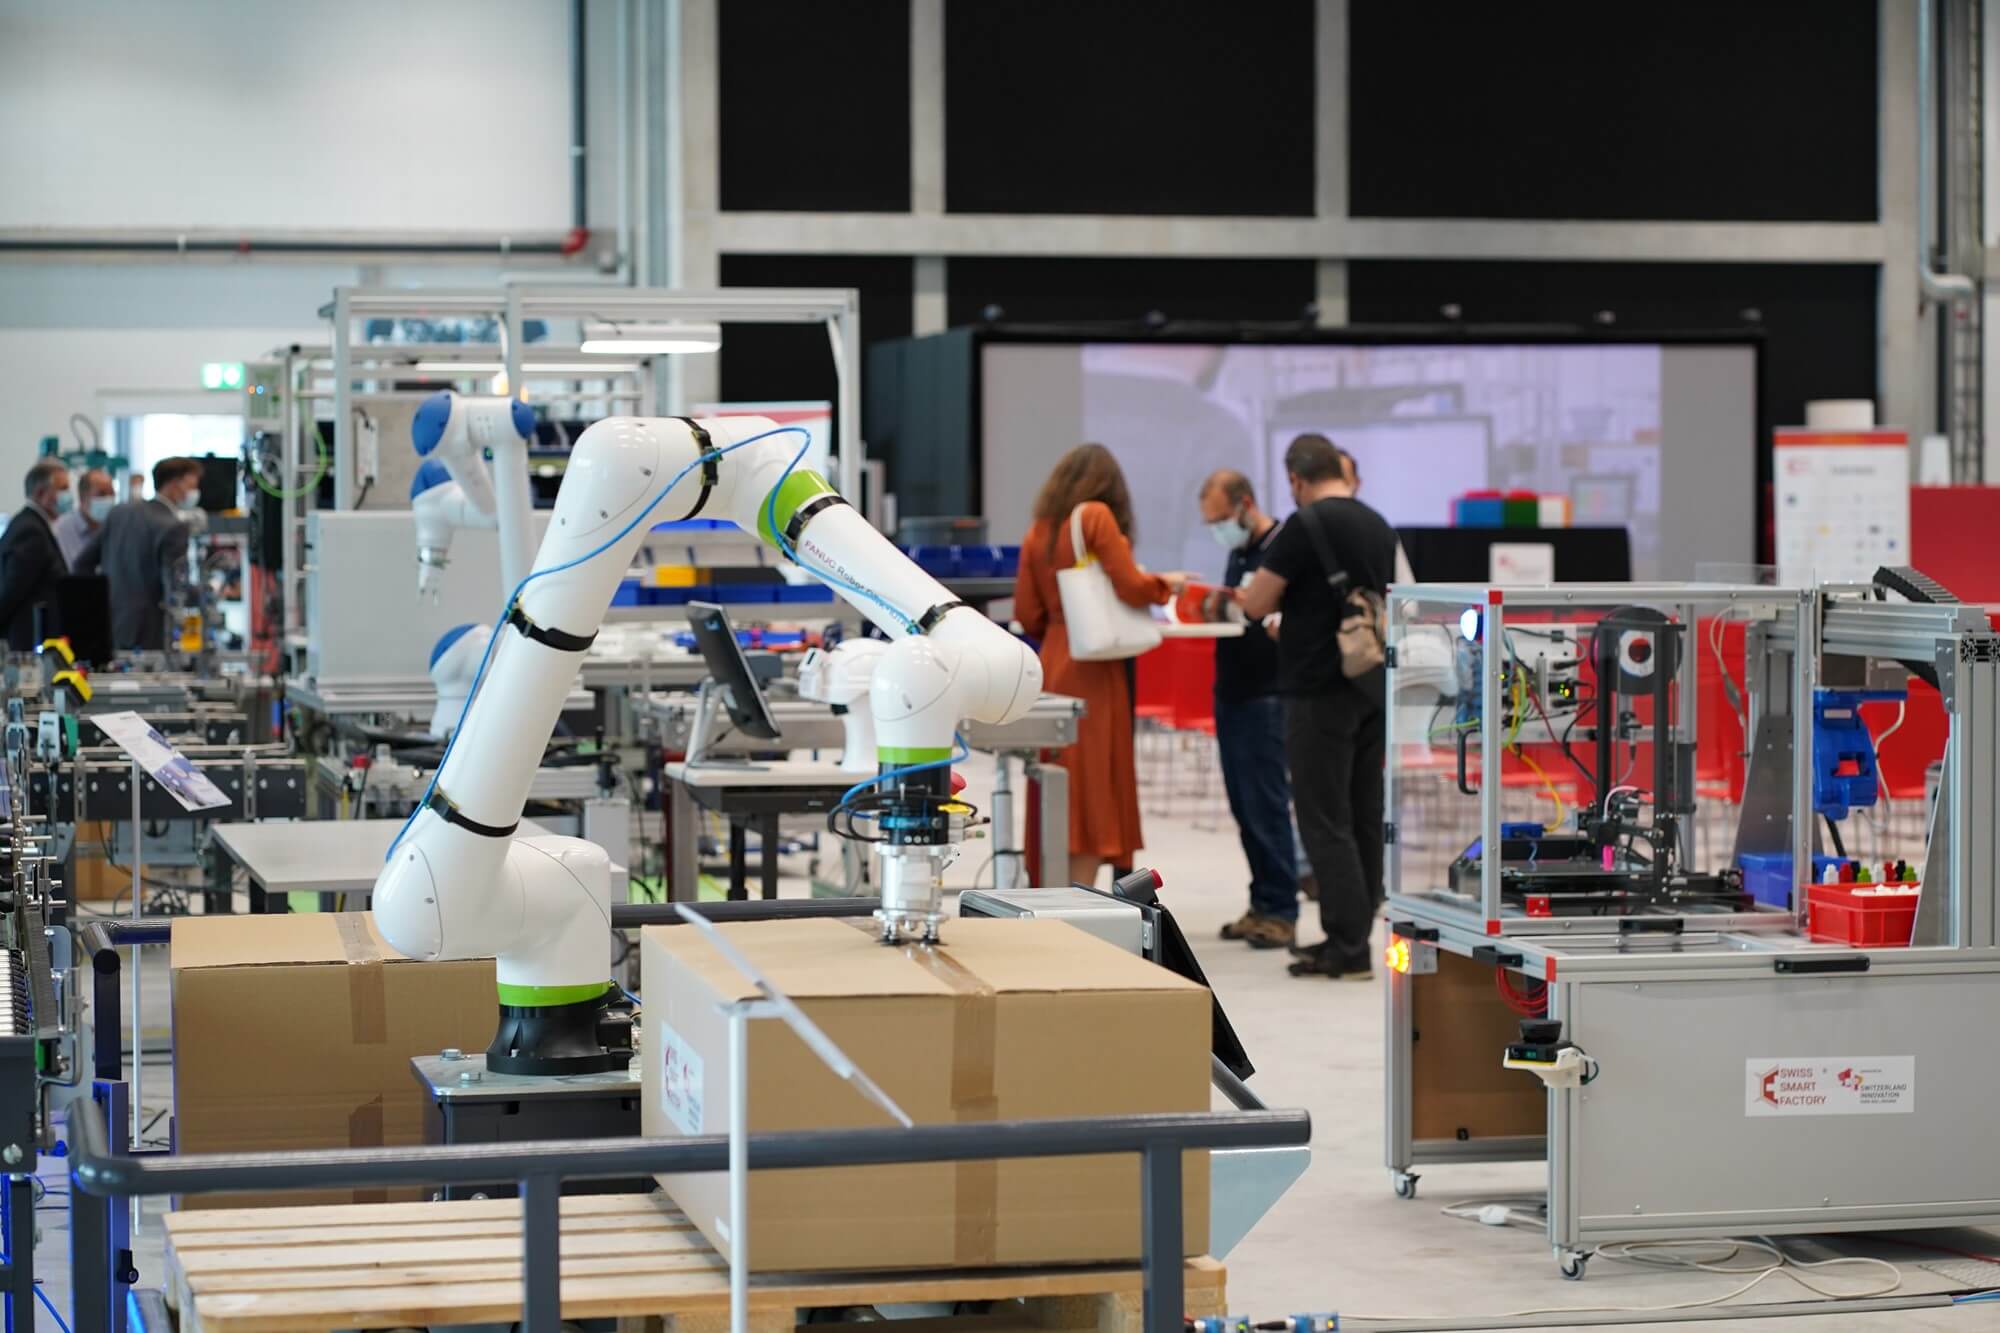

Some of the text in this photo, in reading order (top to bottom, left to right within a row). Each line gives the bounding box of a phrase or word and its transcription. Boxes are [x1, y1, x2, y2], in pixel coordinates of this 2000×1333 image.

[804, 539, 836, 569] FANUC
[1779, 1067, 1814, 1079] SWISS
[1779, 1081, 1816, 1093] SMART
[1778, 1095, 1827, 1107] FACTORY
